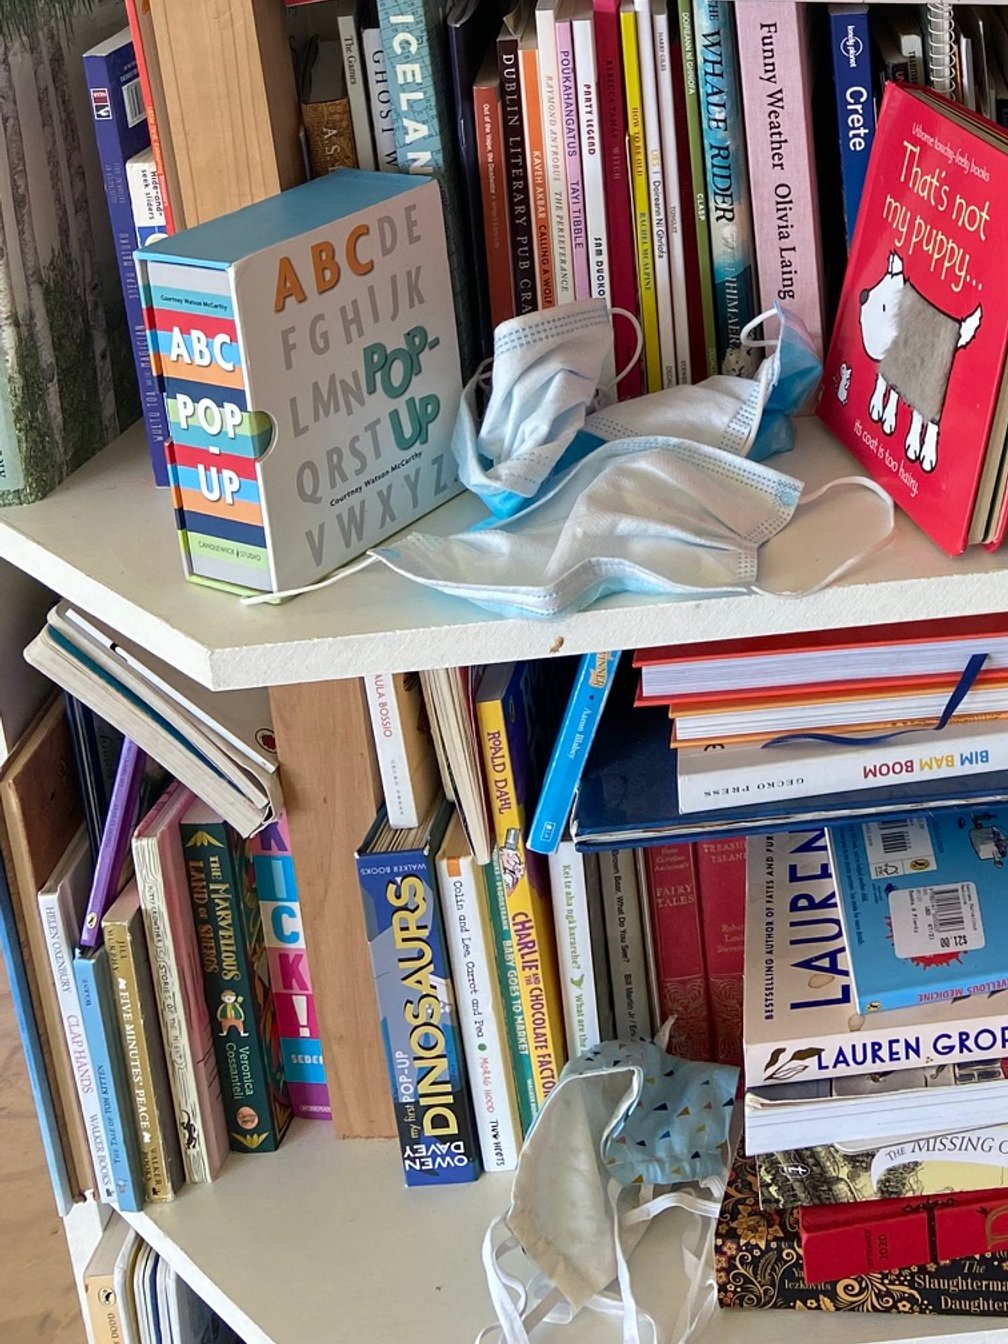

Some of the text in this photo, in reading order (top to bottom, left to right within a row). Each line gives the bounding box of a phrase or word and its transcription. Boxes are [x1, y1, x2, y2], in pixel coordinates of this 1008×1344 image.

[372, 50, 394, 141] GHOST
[845, 86, 866, 151] Crete
[502, 54, 527, 228] DUBLIN LITERARY
[583, 84, 596, 155] PARTY LEGEND
[700, 29, 735, 223] WHALE RIDER
[759, 21, 795, 300] Funny Weather Olivia Laing
[901, 142, 990, 240] That's not
[169, 326, 236, 372] ABC
[176, 393, 244, 441] POP
[197, 463, 241, 506] UP
[329, 487, 362, 508] Courtney
[898, 470, 919, 497] hairy.
[485, 730, 510, 815] ROALD DAHL
[763, 777, 804, 788] GECKO
[862, 749, 990, 778] BOOM BAM BIM
[52, 936, 71, 994] OXENBURY
[940, 935, 969, 948] $21.00
[386, 874, 459, 1136] DINOSAURS
[511, 912, 549, 1053] CHARLIE CHOCOLATE
[515, 1014, 529, 1055] MARKET
[816, 1033, 921, 1071] LAUREN
[134, 1090, 149, 1131] PEACE
[404, 1155, 468, 1170] OWEN
[910, 1134, 994, 1155] MISSING
